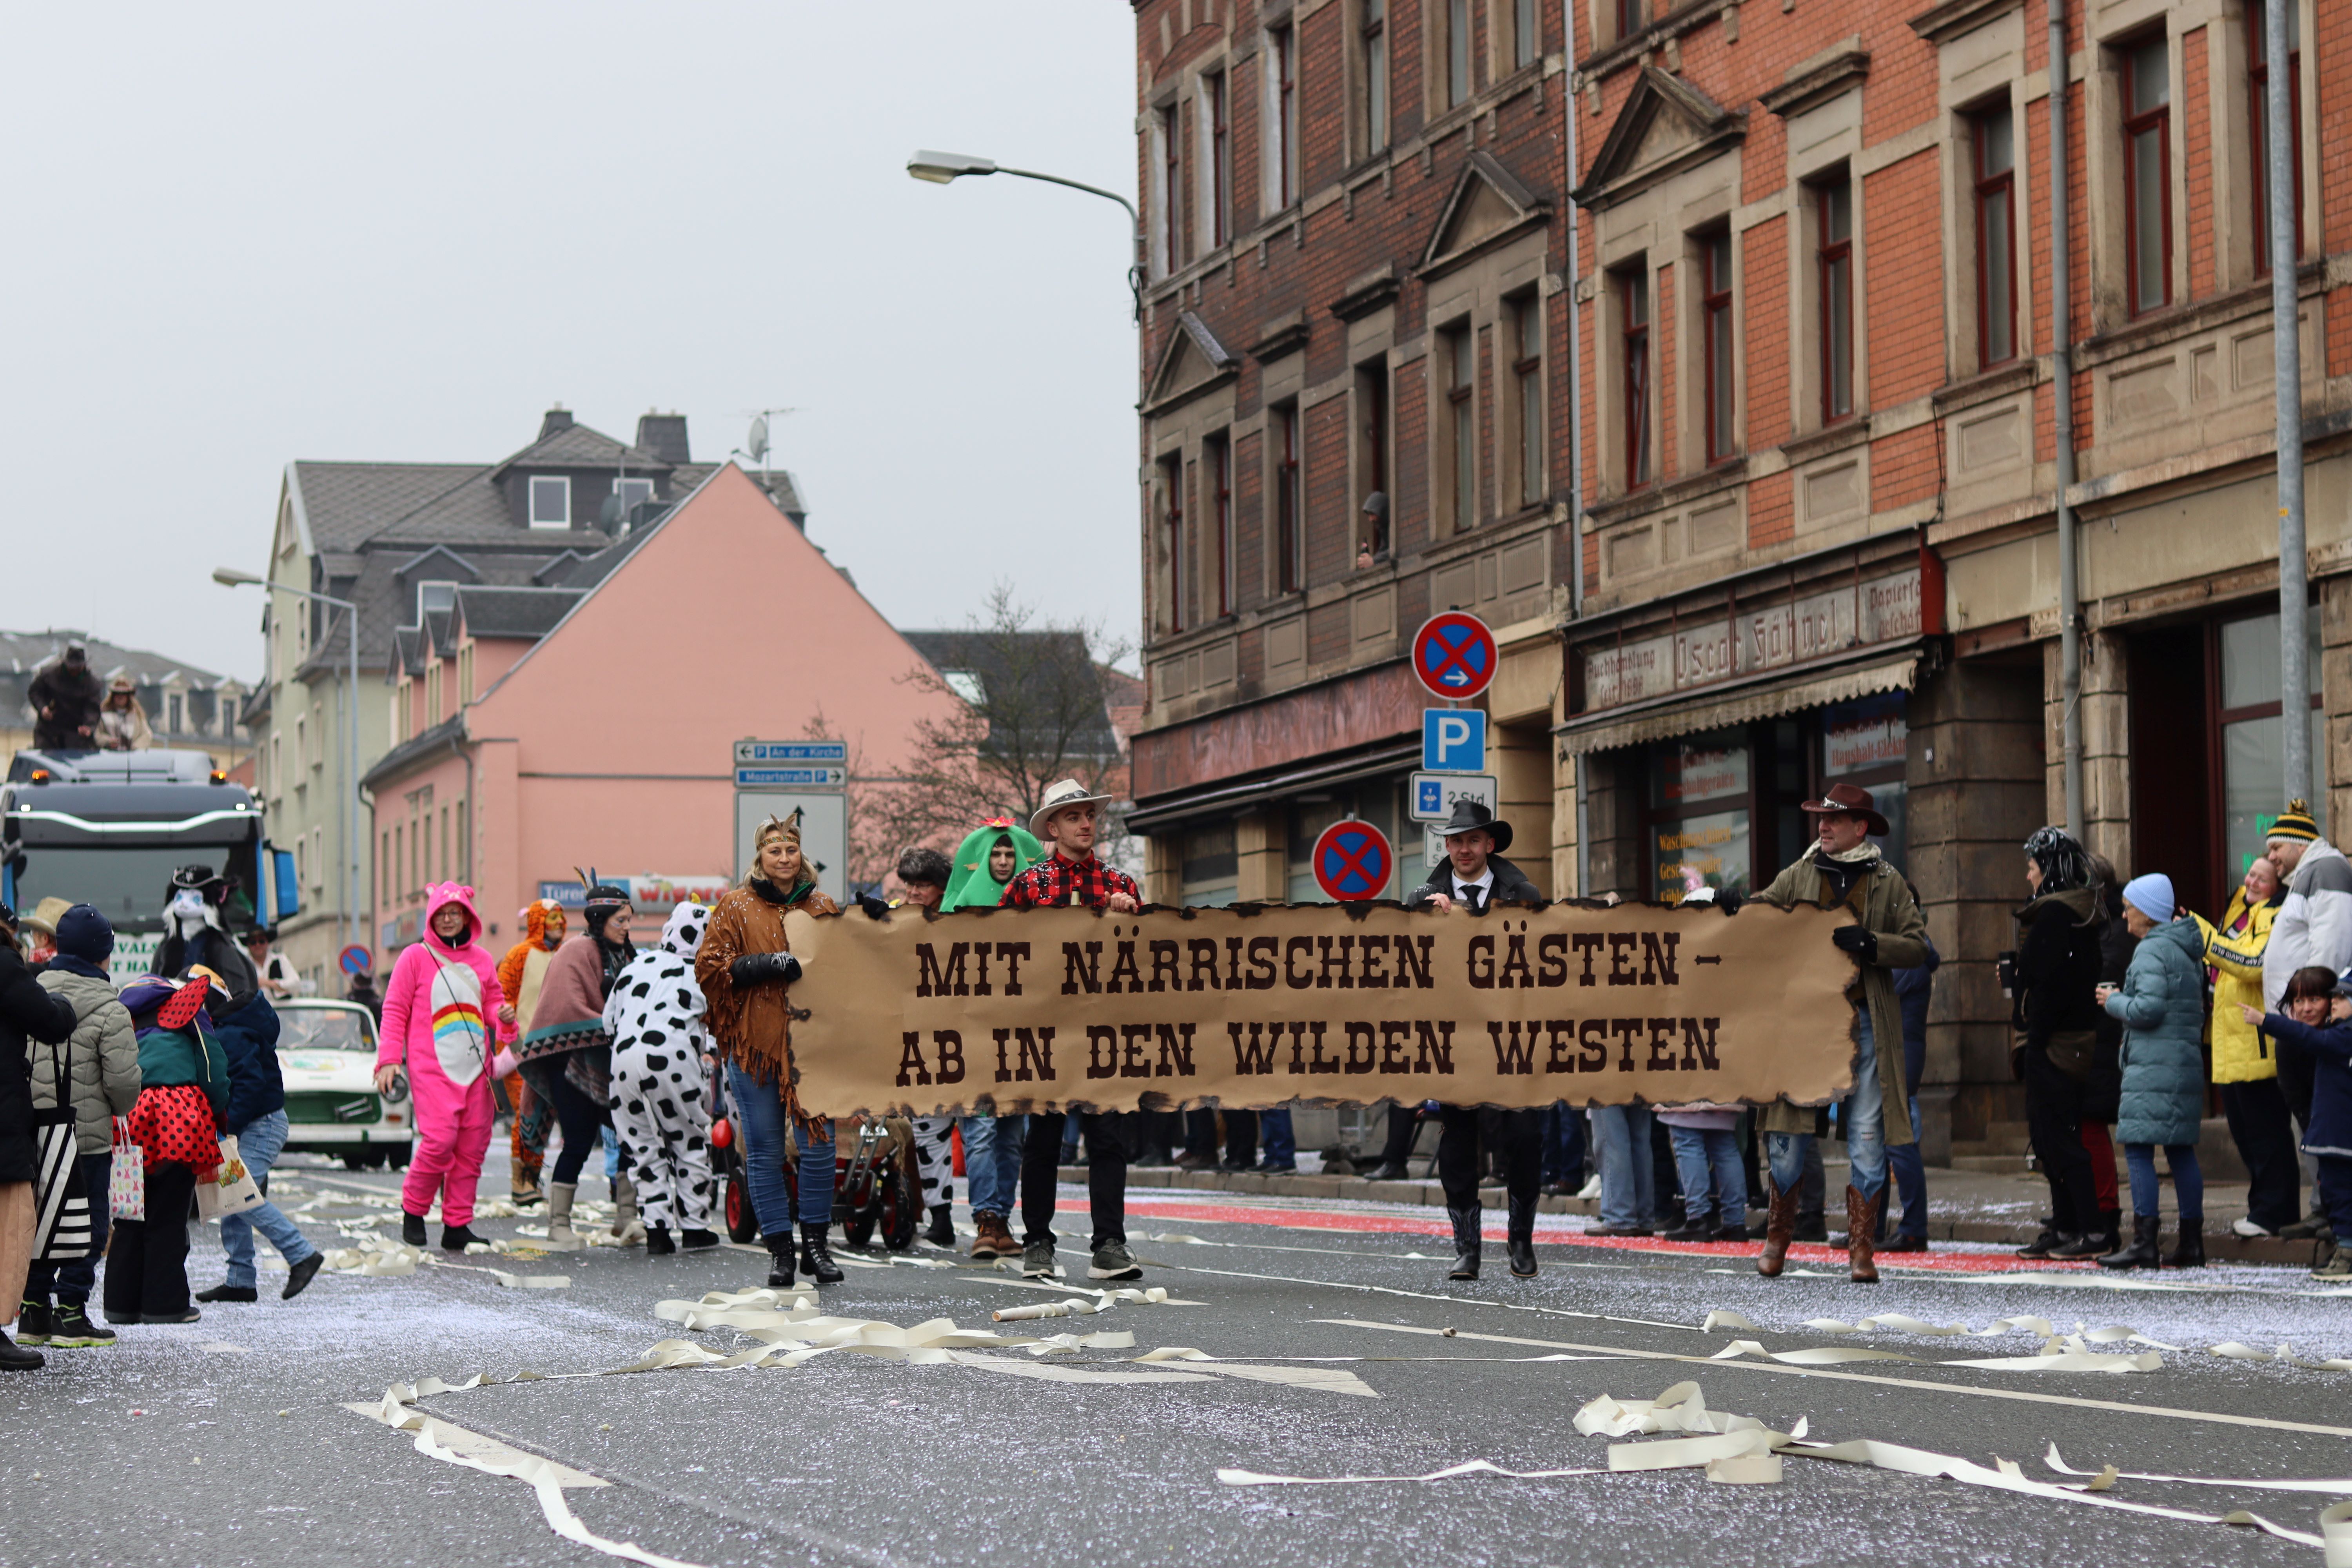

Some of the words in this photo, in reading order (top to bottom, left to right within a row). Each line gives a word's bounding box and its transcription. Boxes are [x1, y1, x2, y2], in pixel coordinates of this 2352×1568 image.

[1677, 635, 1742, 682] Oscar
[1753, 599, 1838, 668] Hähnel
[757, 748, 764, 756] P
[772, 748, 785, 756] An
[789, 748, 805, 756] der
[810, 747, 841, 756] Kirche
[1438, 717, 1470, 762] P
[746, 772, 810, 781] Mozartstraße
[817, 771, 824, 780] P
[1448, 791, 1456, 804] 2
[1461, 792, 1488, 806] Std.
[1659, 826, 1731, 851] Waschmaschinen
[916, 942, 1030, 997] MIT
[1061, 925, 1434, 995] NÄRRISCHEN
[2225, 951, 2245, 964] DAVID
[896, 1030, 965, 1087] AB
[993, 1027, 1055, 1083] IN
[1087, 1023, 1196, 1079] DEN
[1227, 1020, 1455, 1075] WILDEN
[1487, 1017, 1720, 1074] WESTEN
